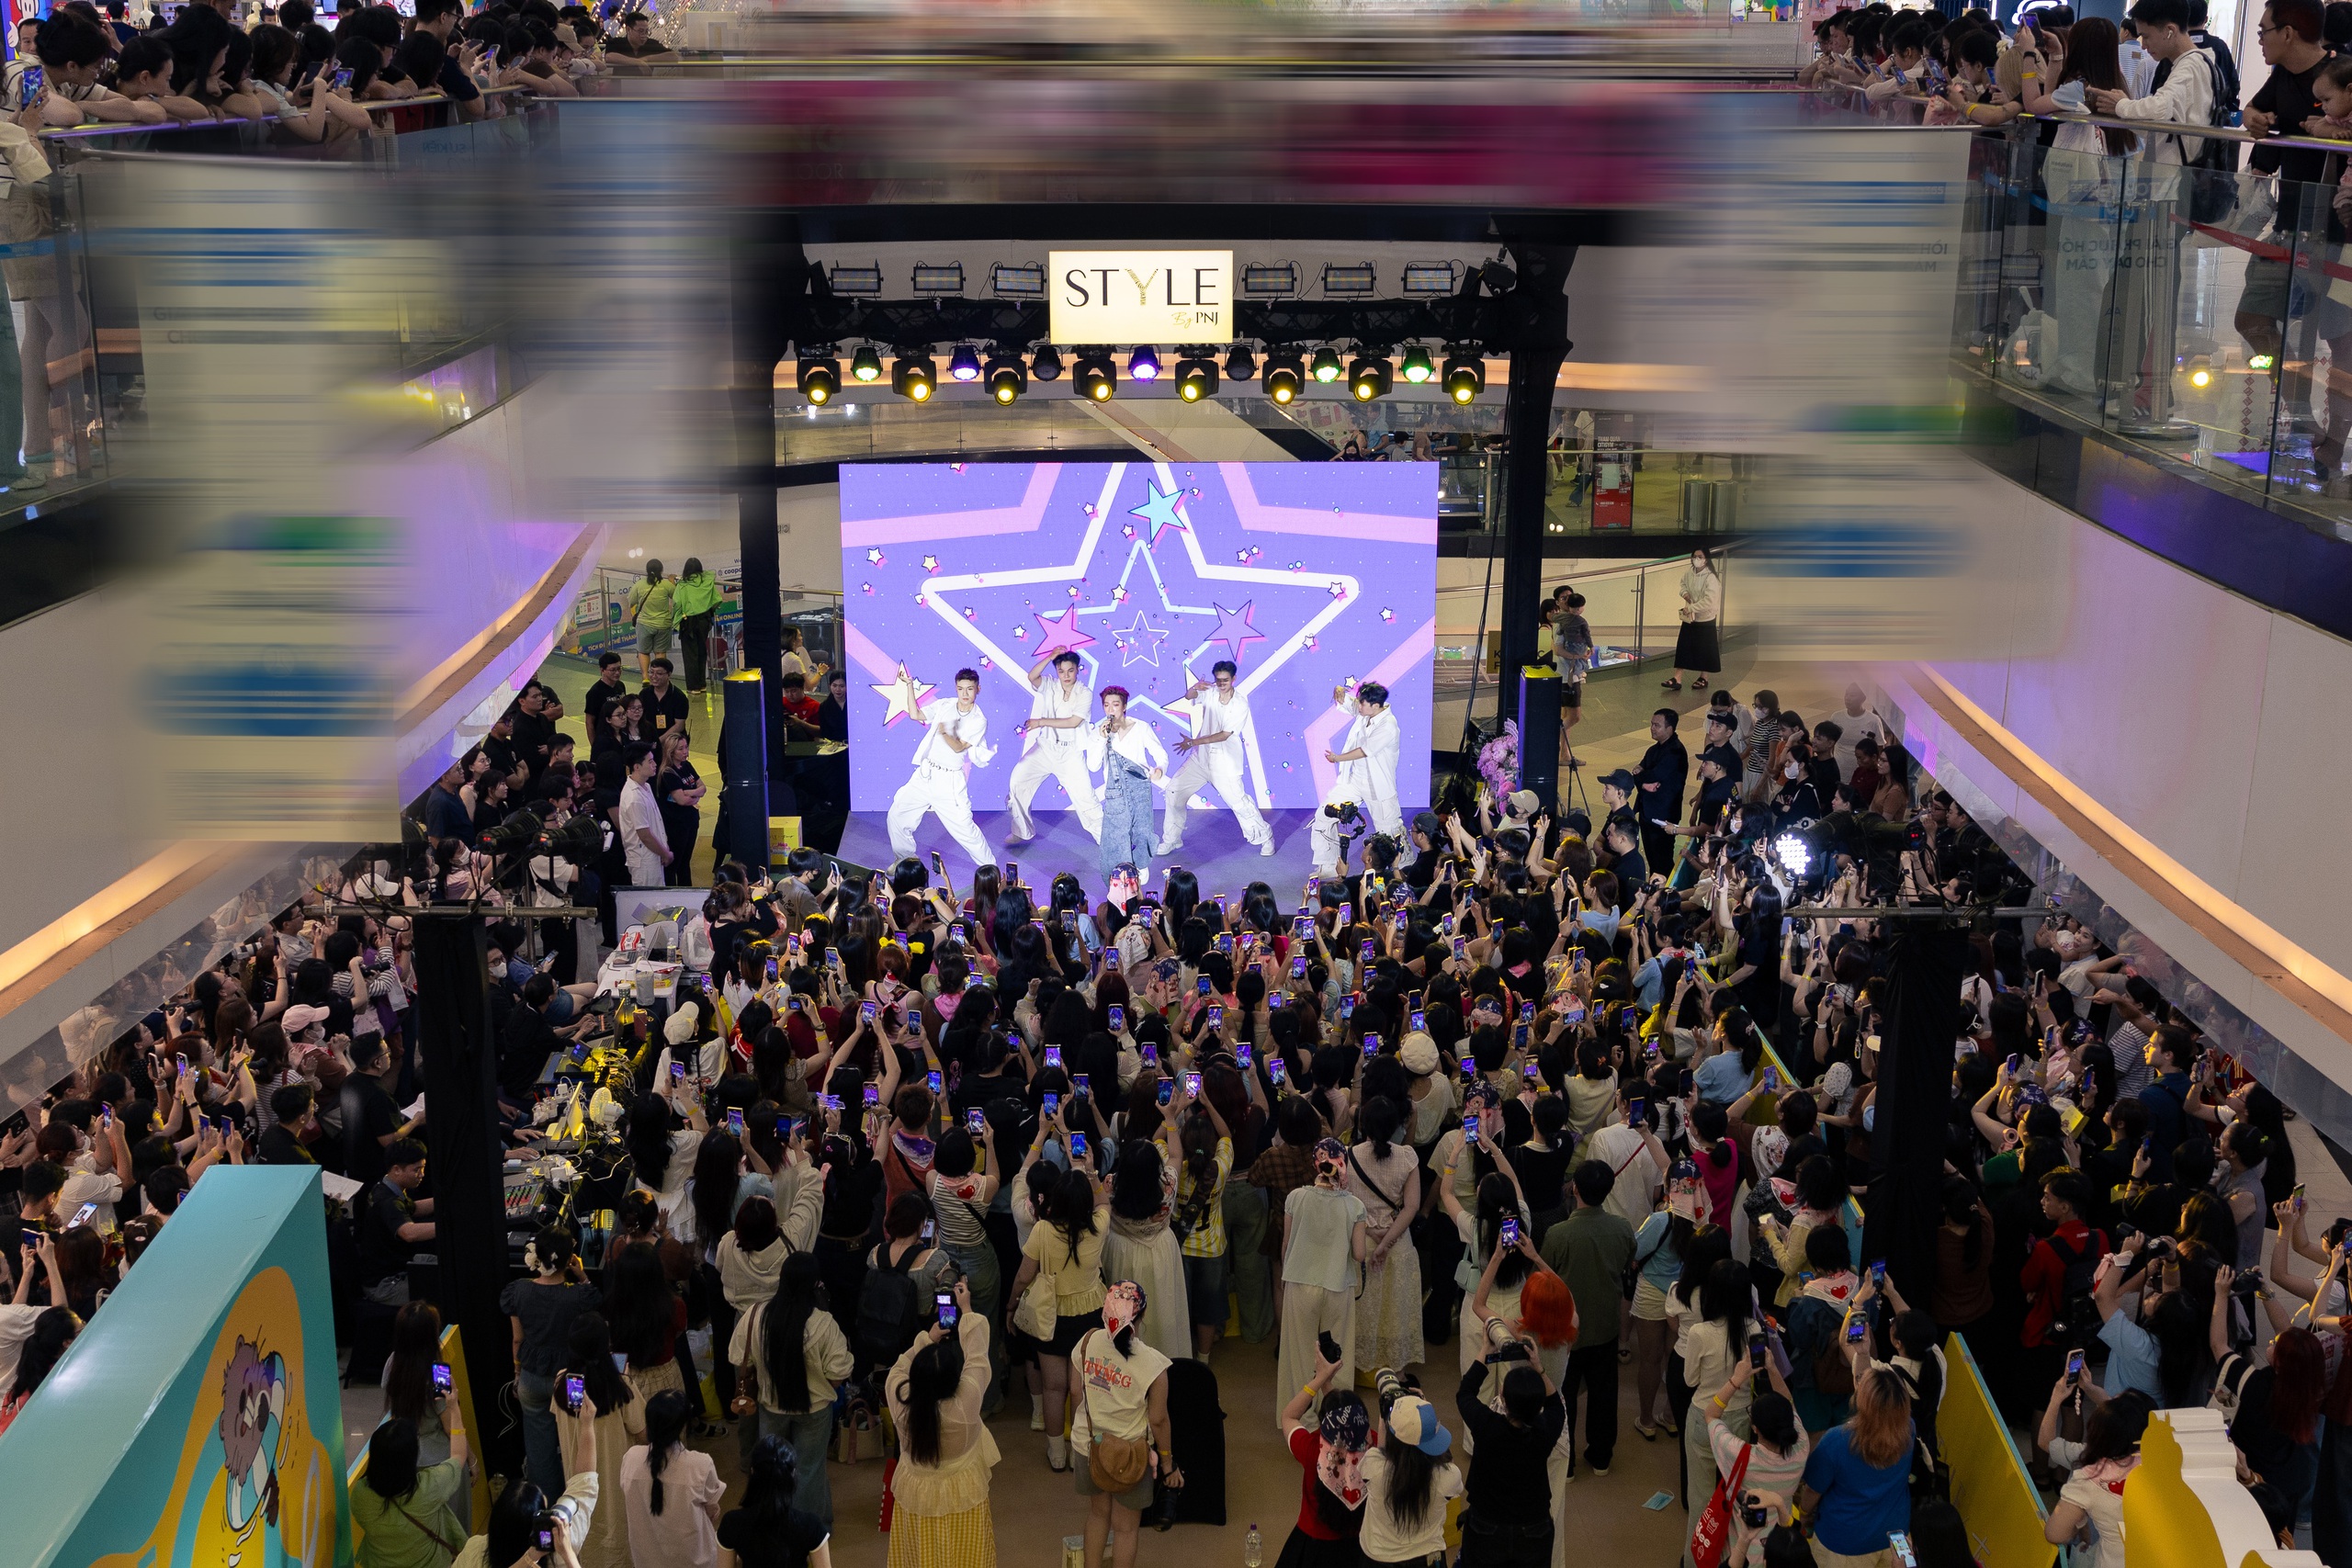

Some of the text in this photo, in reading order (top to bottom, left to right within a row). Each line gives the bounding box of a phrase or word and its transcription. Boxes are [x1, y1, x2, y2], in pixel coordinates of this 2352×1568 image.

[1065, 268, 1219, 308] STYLE
[1171, 311, 1219, 329] By PNJ
